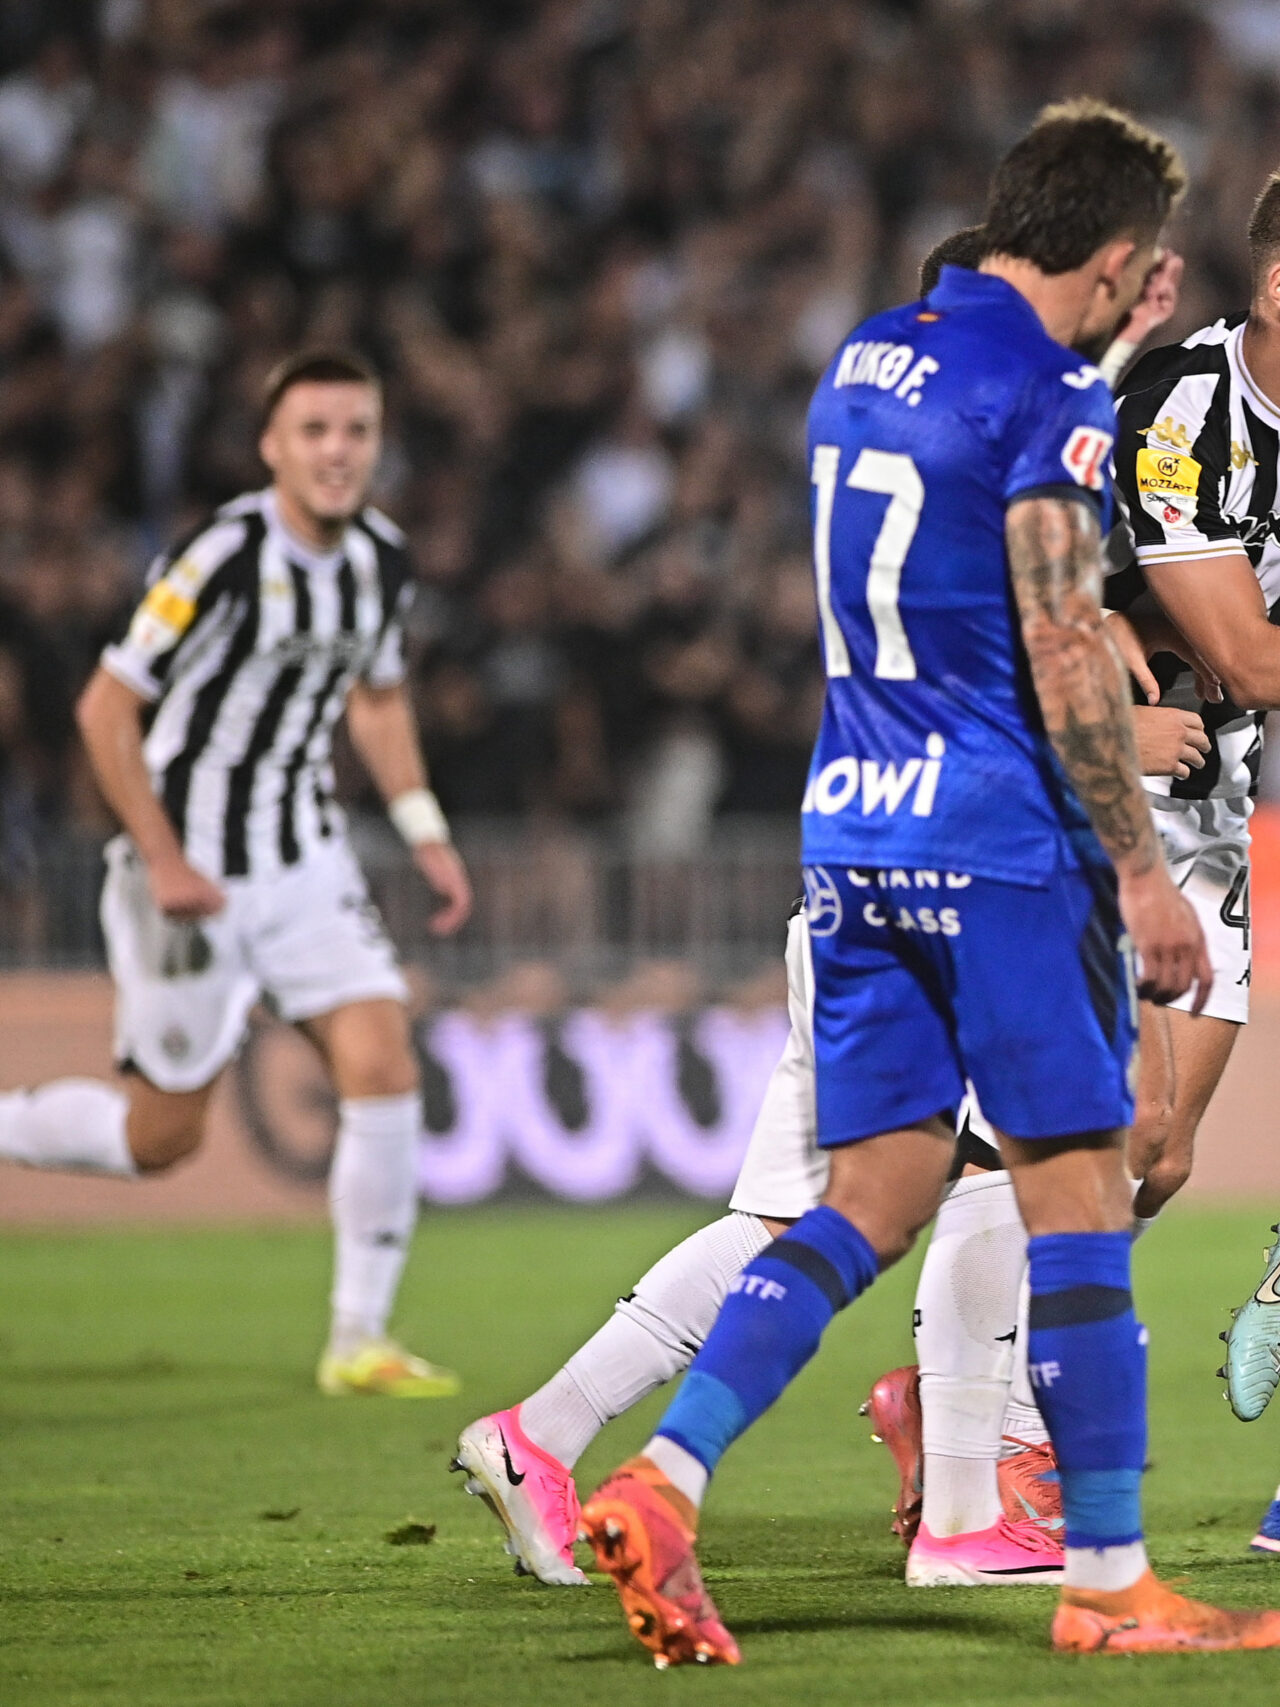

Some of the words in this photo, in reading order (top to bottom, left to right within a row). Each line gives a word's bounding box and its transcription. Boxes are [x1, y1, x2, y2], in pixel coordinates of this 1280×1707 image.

[833, 341, 914, 390] KIKO
[895, 355, 940, 407] F.
[811, 445, 925, 681] 17
[863, 902, 962, 937] CASS
